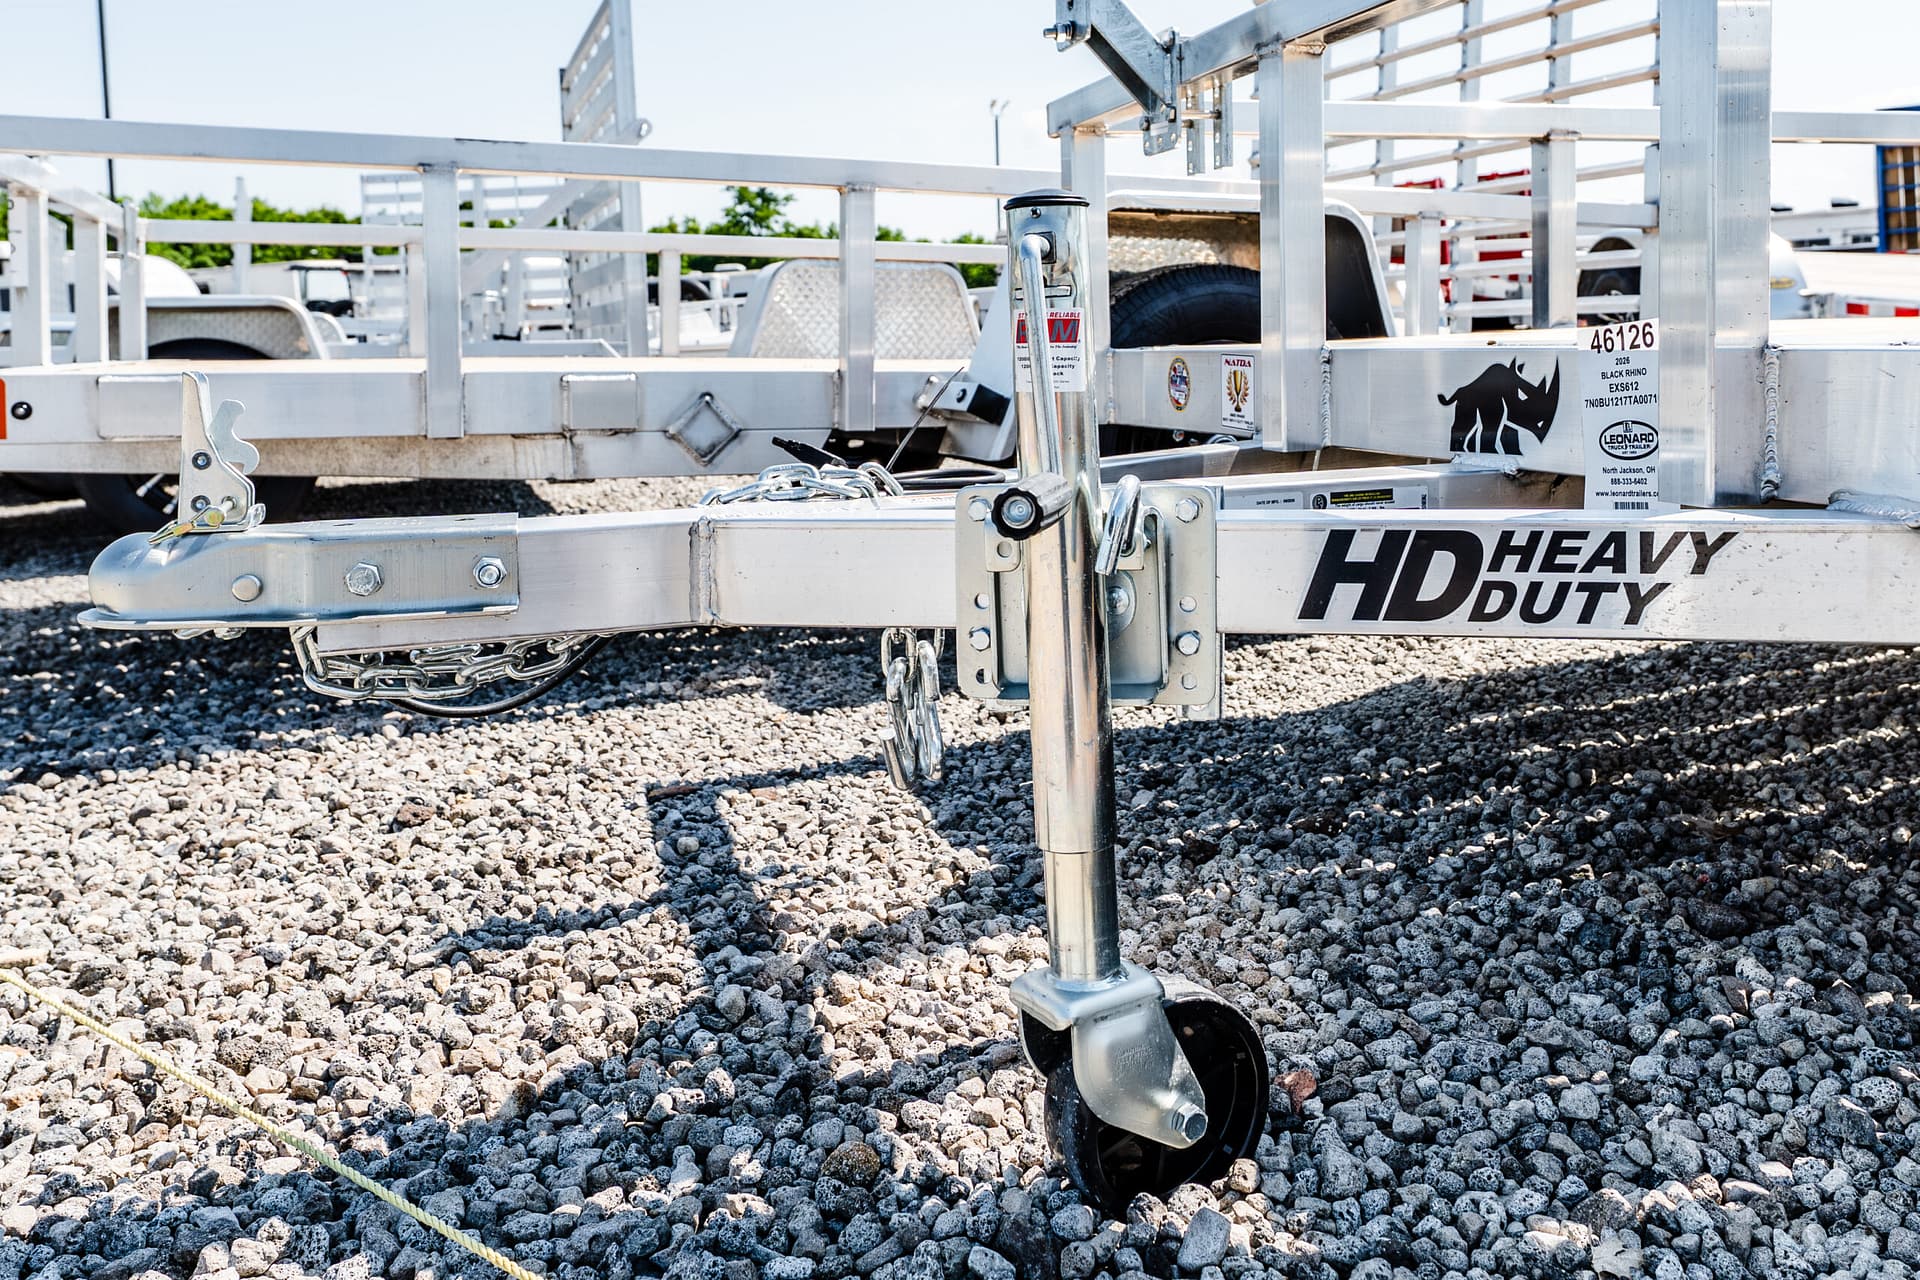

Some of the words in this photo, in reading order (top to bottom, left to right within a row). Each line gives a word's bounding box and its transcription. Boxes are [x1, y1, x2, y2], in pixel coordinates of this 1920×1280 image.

[1017, 320, 1079, 342] RM
[1591, 322, 1655, 354] 46126
[1224, 358, 1252, 368] NATDA
[1615, 356, 1631, 366] 2026
[1601, 370, 1624, 380] BLACK
[1625, 367, 1647, 377] RHINO
[1609, 381, 1639, 393] EXS612
[1604, 433, 1655, 445] LEONARD
[1602, 466, 1618, 475] North
[1619, 466, 1645, 475] Jackson,
[1646, 465, 1656, 474] OH
[1298, 529, 1484, 622] HD
[1487, 530, 1740, 575] HEAVY
[1467, 579, 1671, 625] DUTY
